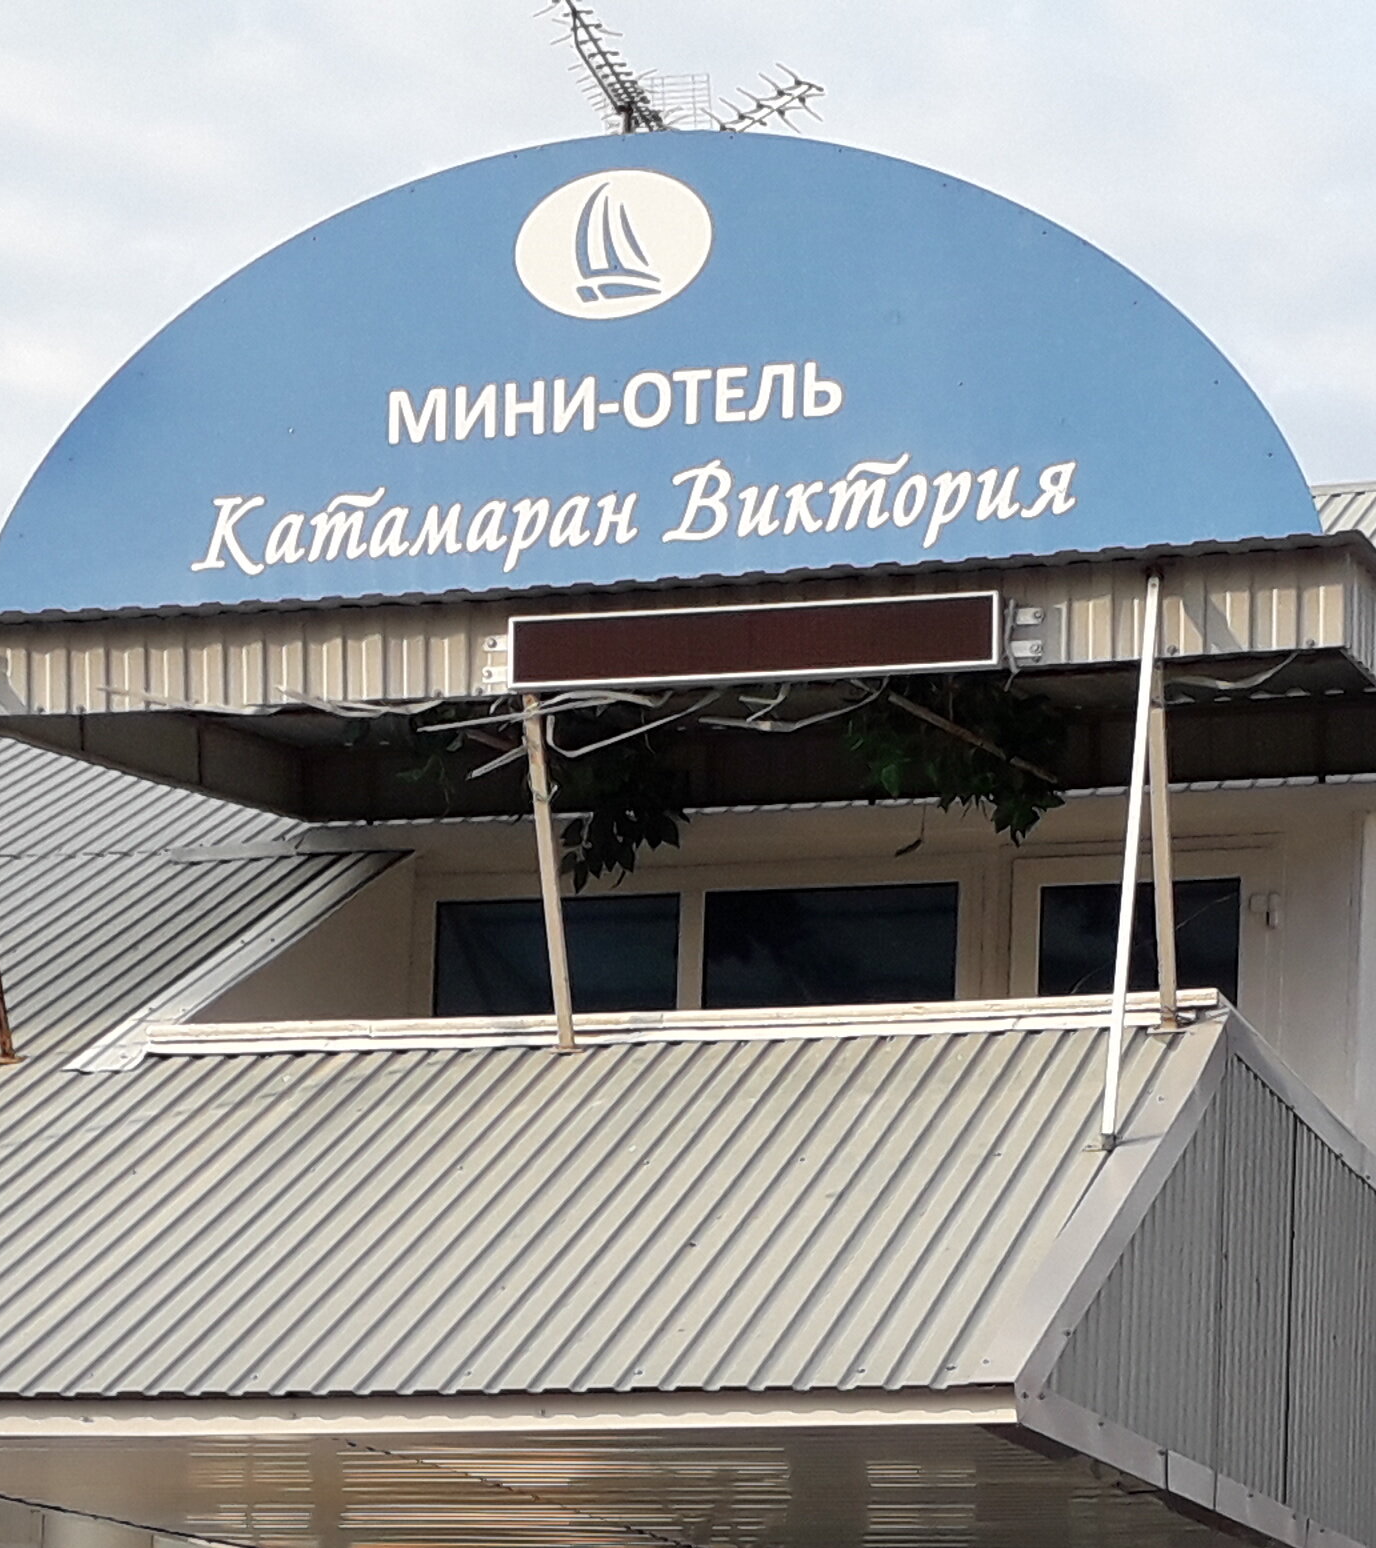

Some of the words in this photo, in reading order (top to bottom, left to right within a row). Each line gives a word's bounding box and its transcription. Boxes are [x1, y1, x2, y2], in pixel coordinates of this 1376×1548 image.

[386, 362, 843, 445] МИНИ-ОТЕЛЬ
[191, 487, 638, 575] Катамаран
[662, 454, 1078, 548] Виктория
